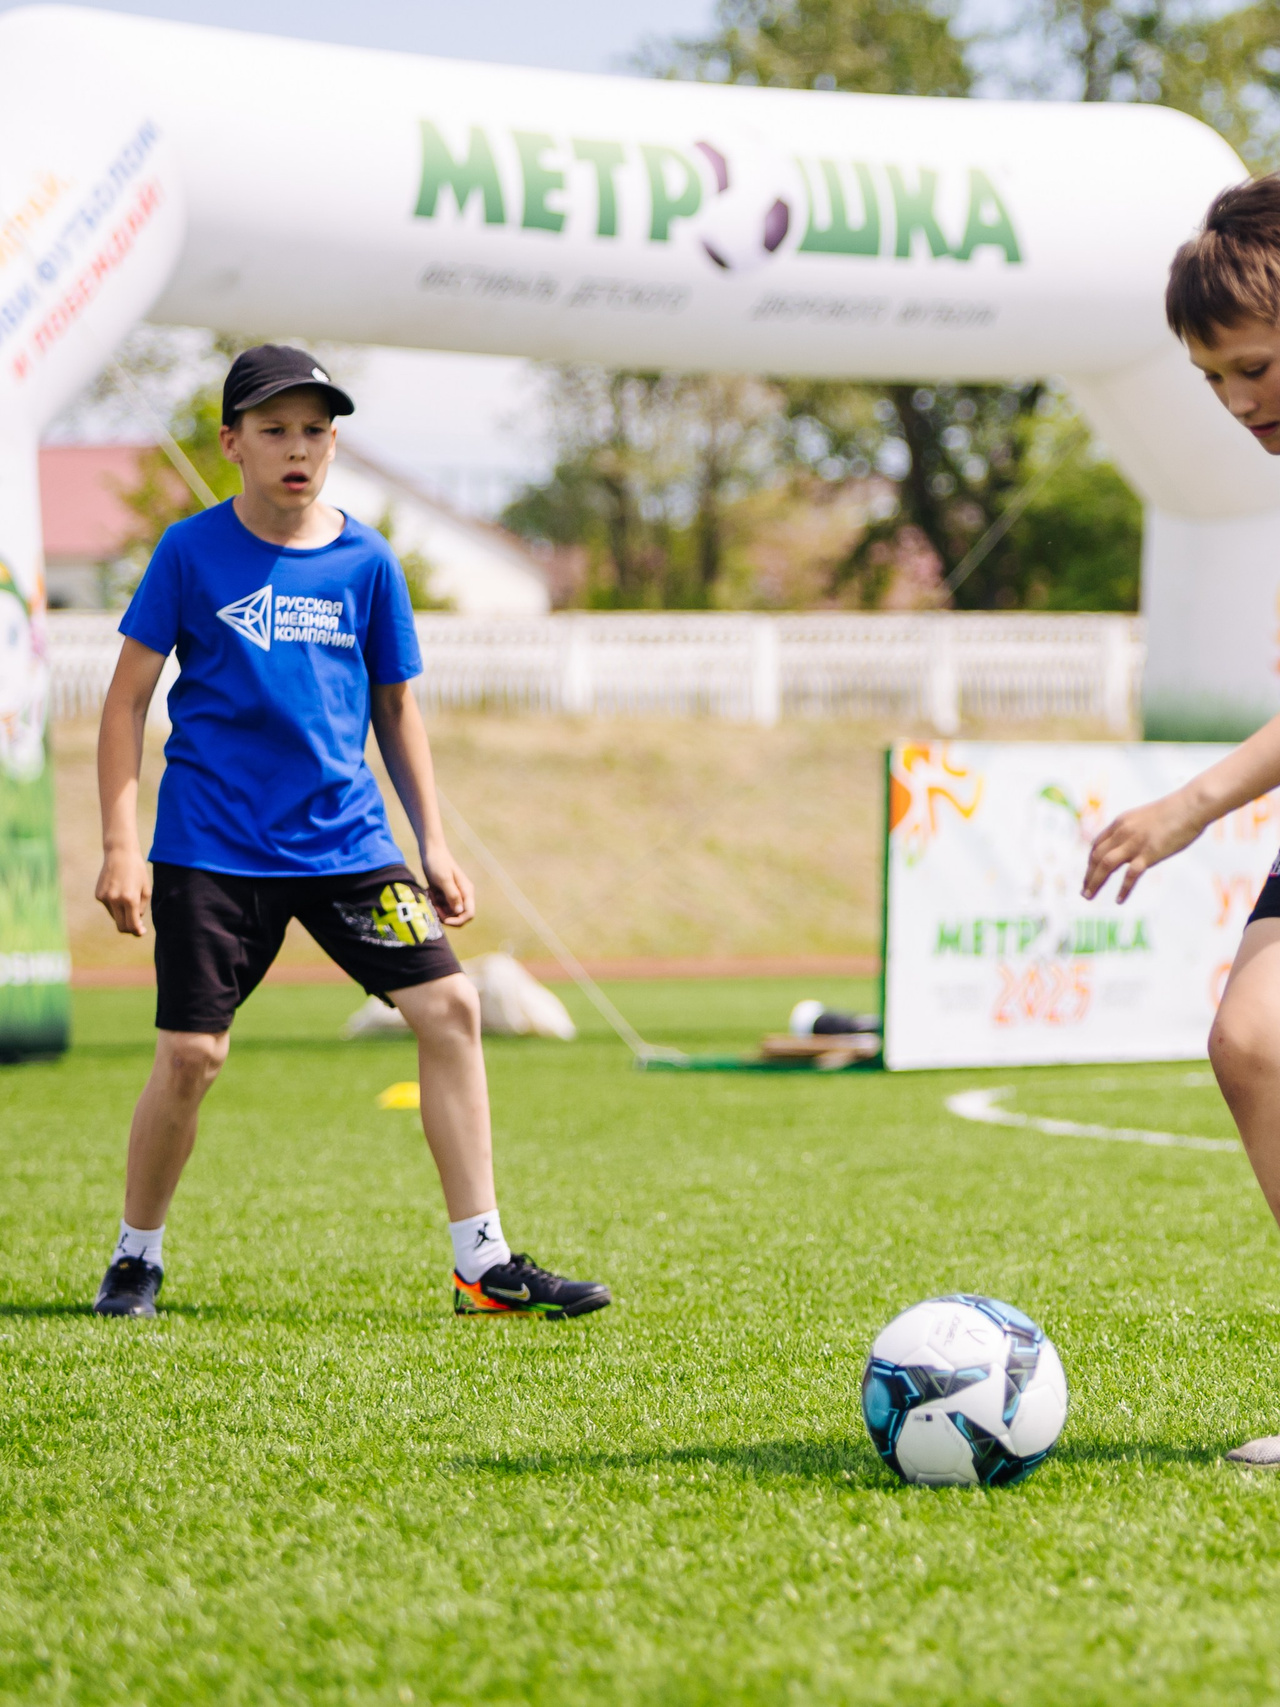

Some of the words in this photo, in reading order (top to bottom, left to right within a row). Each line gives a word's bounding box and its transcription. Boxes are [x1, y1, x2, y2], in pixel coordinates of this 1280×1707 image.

[274, 595, 344, 617] РУССКАЯ
[274, 610, 340, 631] МЕДНАЯ
[273, 625, 356, 649] КОМПАНИЯ
[992, 959, 1093, 1027] 2025
